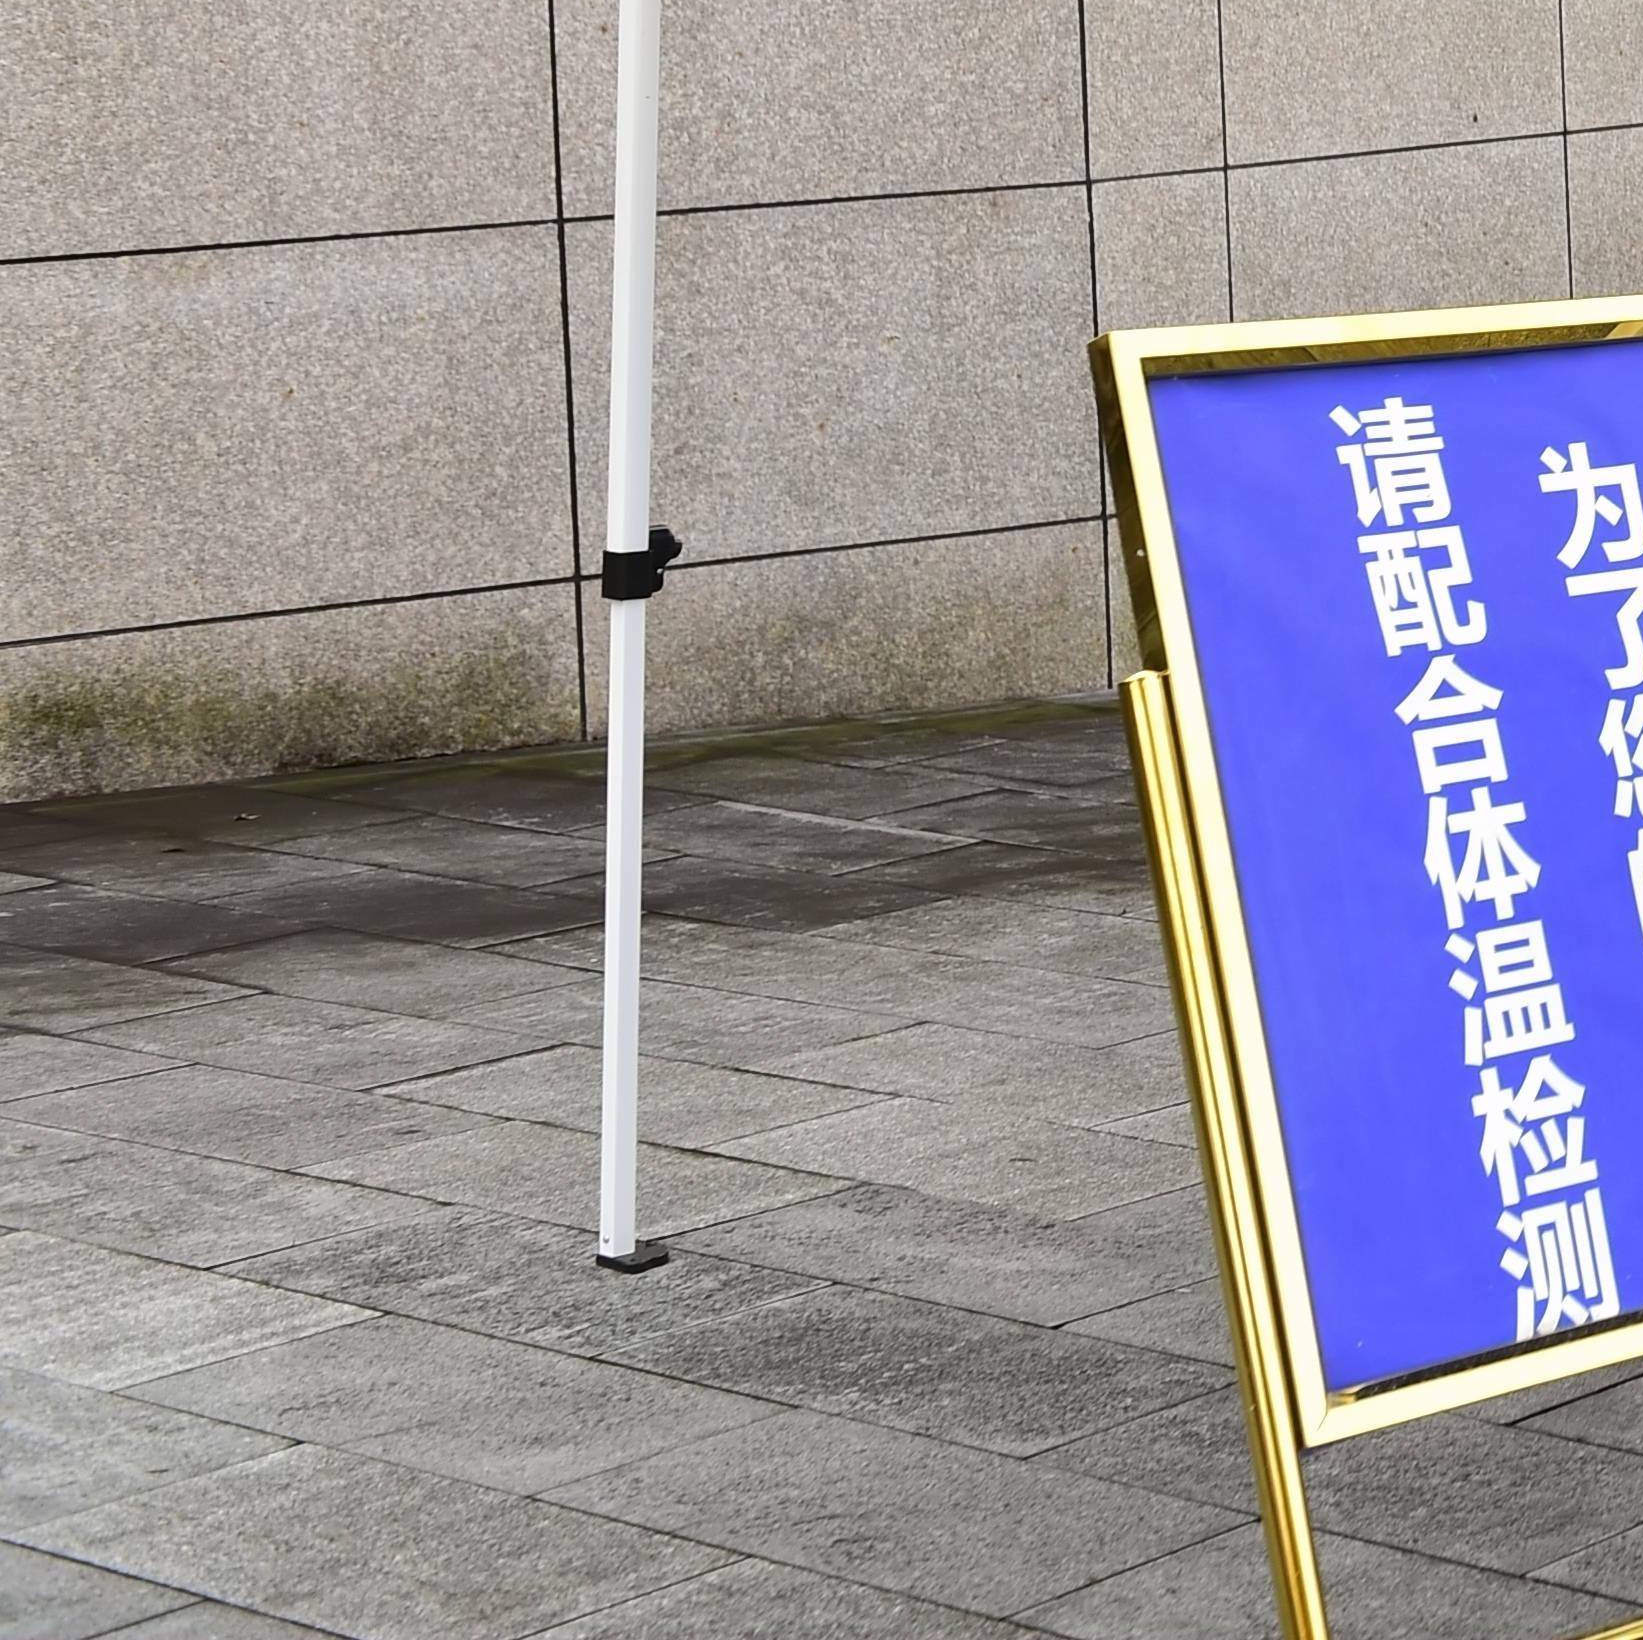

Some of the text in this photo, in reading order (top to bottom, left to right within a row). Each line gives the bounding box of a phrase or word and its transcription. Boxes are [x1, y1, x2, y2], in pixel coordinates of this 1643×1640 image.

[1329, 396, 1621, 1341] 请配合体温检测
